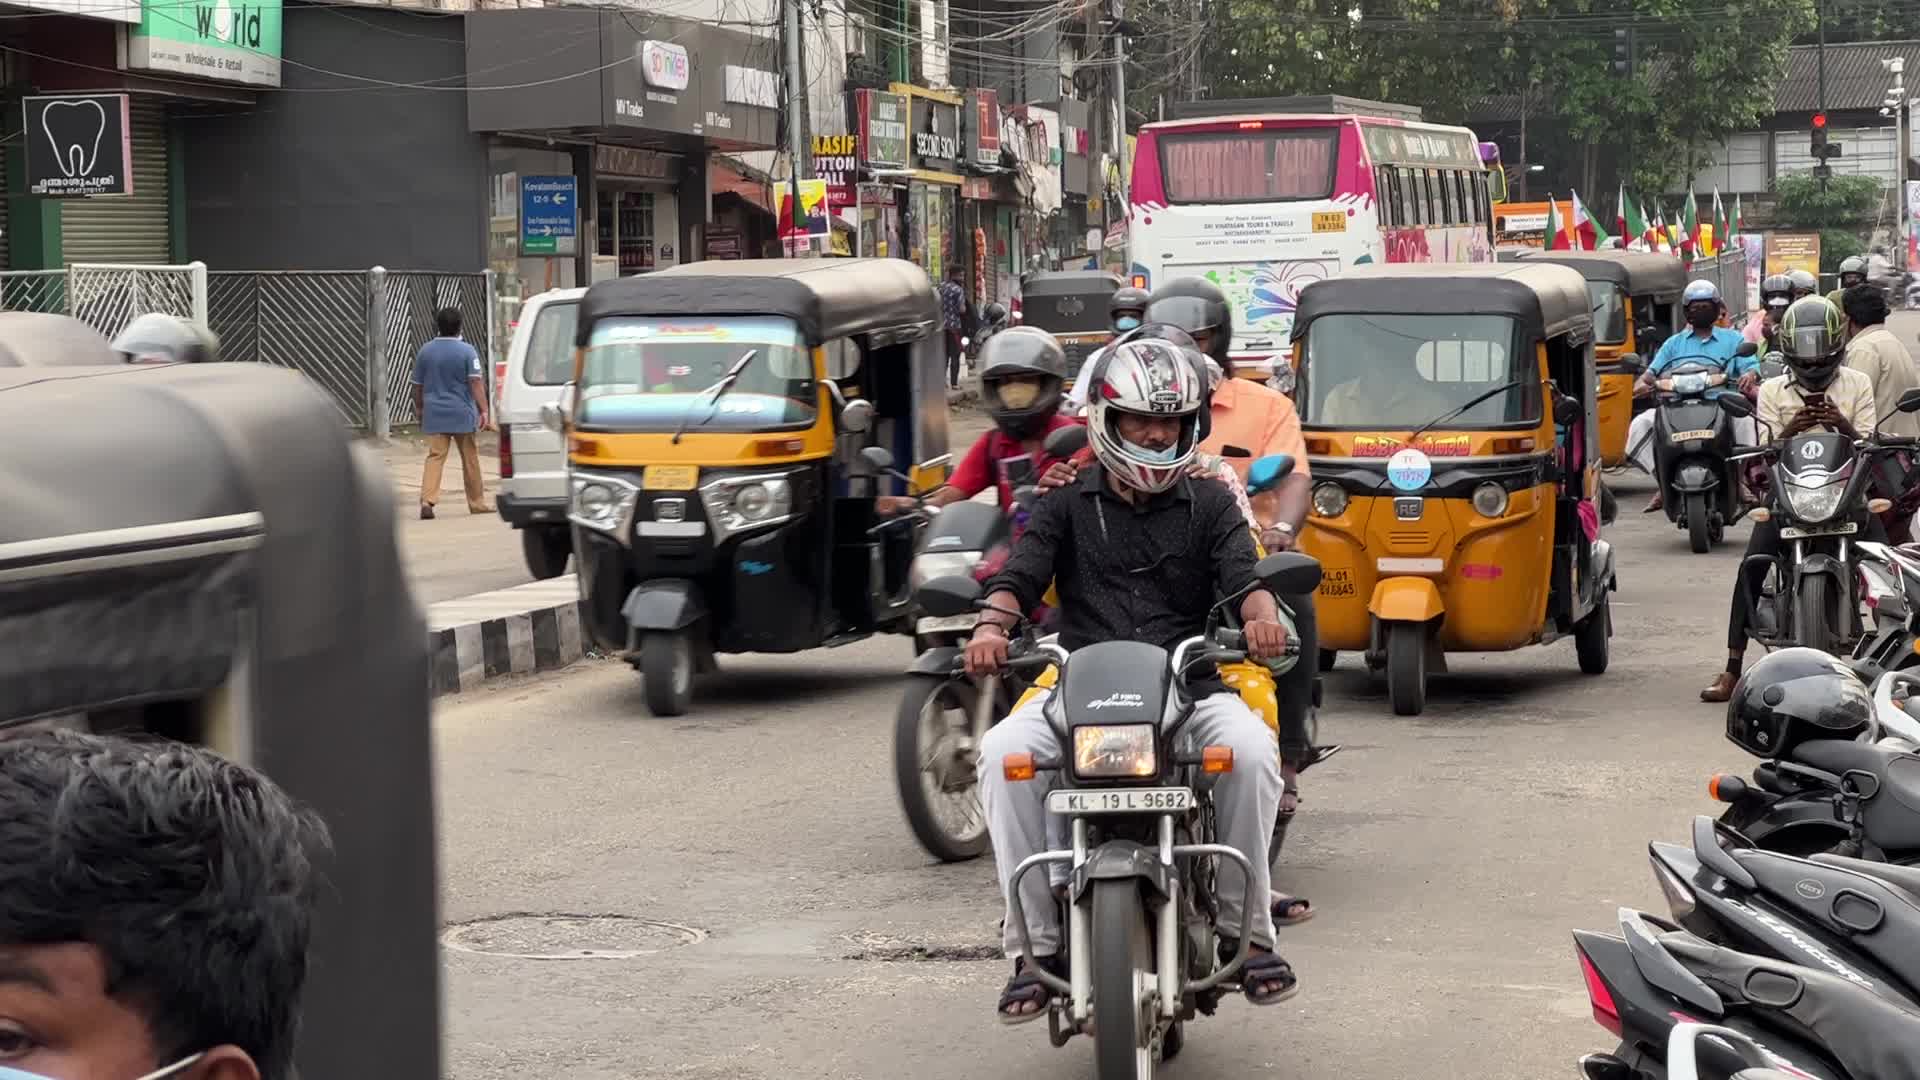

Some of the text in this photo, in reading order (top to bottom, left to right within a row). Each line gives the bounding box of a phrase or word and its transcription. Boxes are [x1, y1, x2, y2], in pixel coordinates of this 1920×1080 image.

[185, 52, 216, 67] Wholesale
[217, 58, 223, 69] &
[225, 59, 242, 72] Retail
[916, 132, 939, 157] SECOND
[814, 156, 855, 170] UTTON
[816, 172, 846, 186] TALL
[1400, 504, 1418, 516] RE
[1068, 793, 1186, 810] KL 19 L 9682
